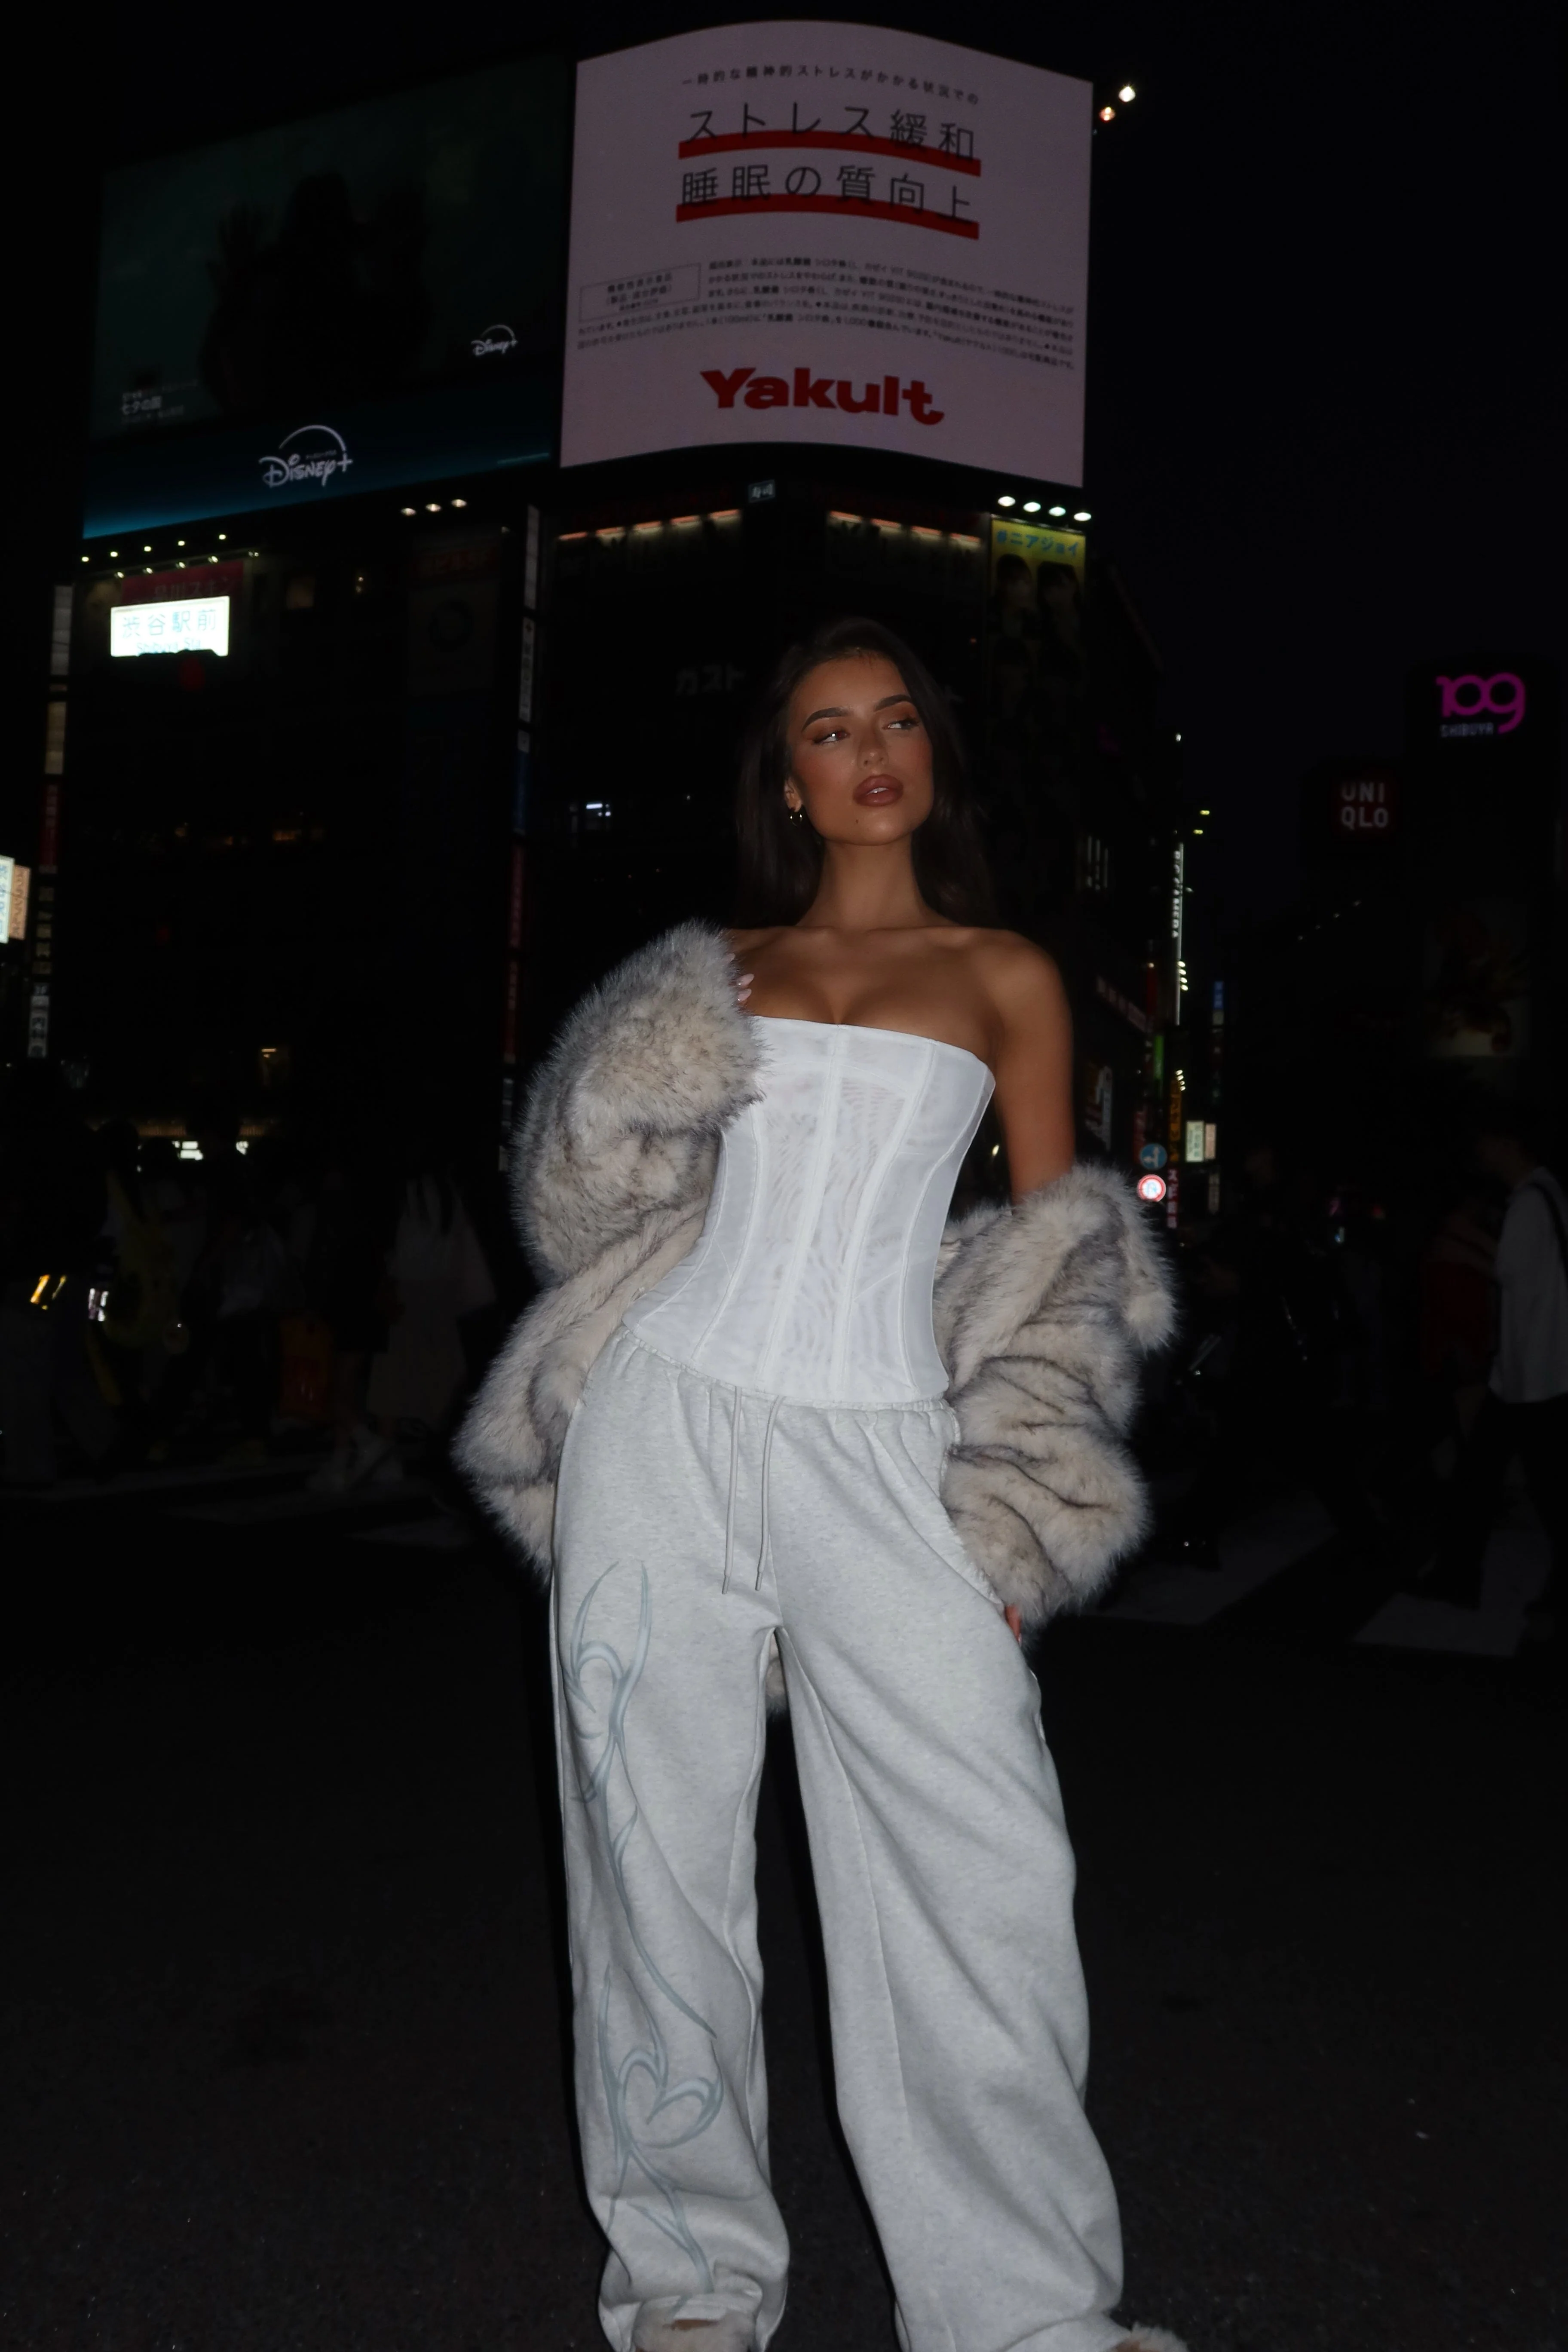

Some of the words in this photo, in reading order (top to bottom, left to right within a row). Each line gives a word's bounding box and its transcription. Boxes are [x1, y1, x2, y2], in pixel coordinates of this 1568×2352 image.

[687, 102, 974, 162] ストレス緩和
[682, 164, 974, 224] 睡眠の質向上
[700, 367, 944, 425] Yakult
[258, 453, 353, 488] Disney+
[122, 609, 216, 637] 渋谷駅前
[674, 661, 747, 697] ガスト
[1434, 671, 1526, 735] 109
[1439, 722, 1494, 737] SHIBUYA
[1340, 781, 1385, 803] UNI
[1341, 805, 1389, 832] QLO
